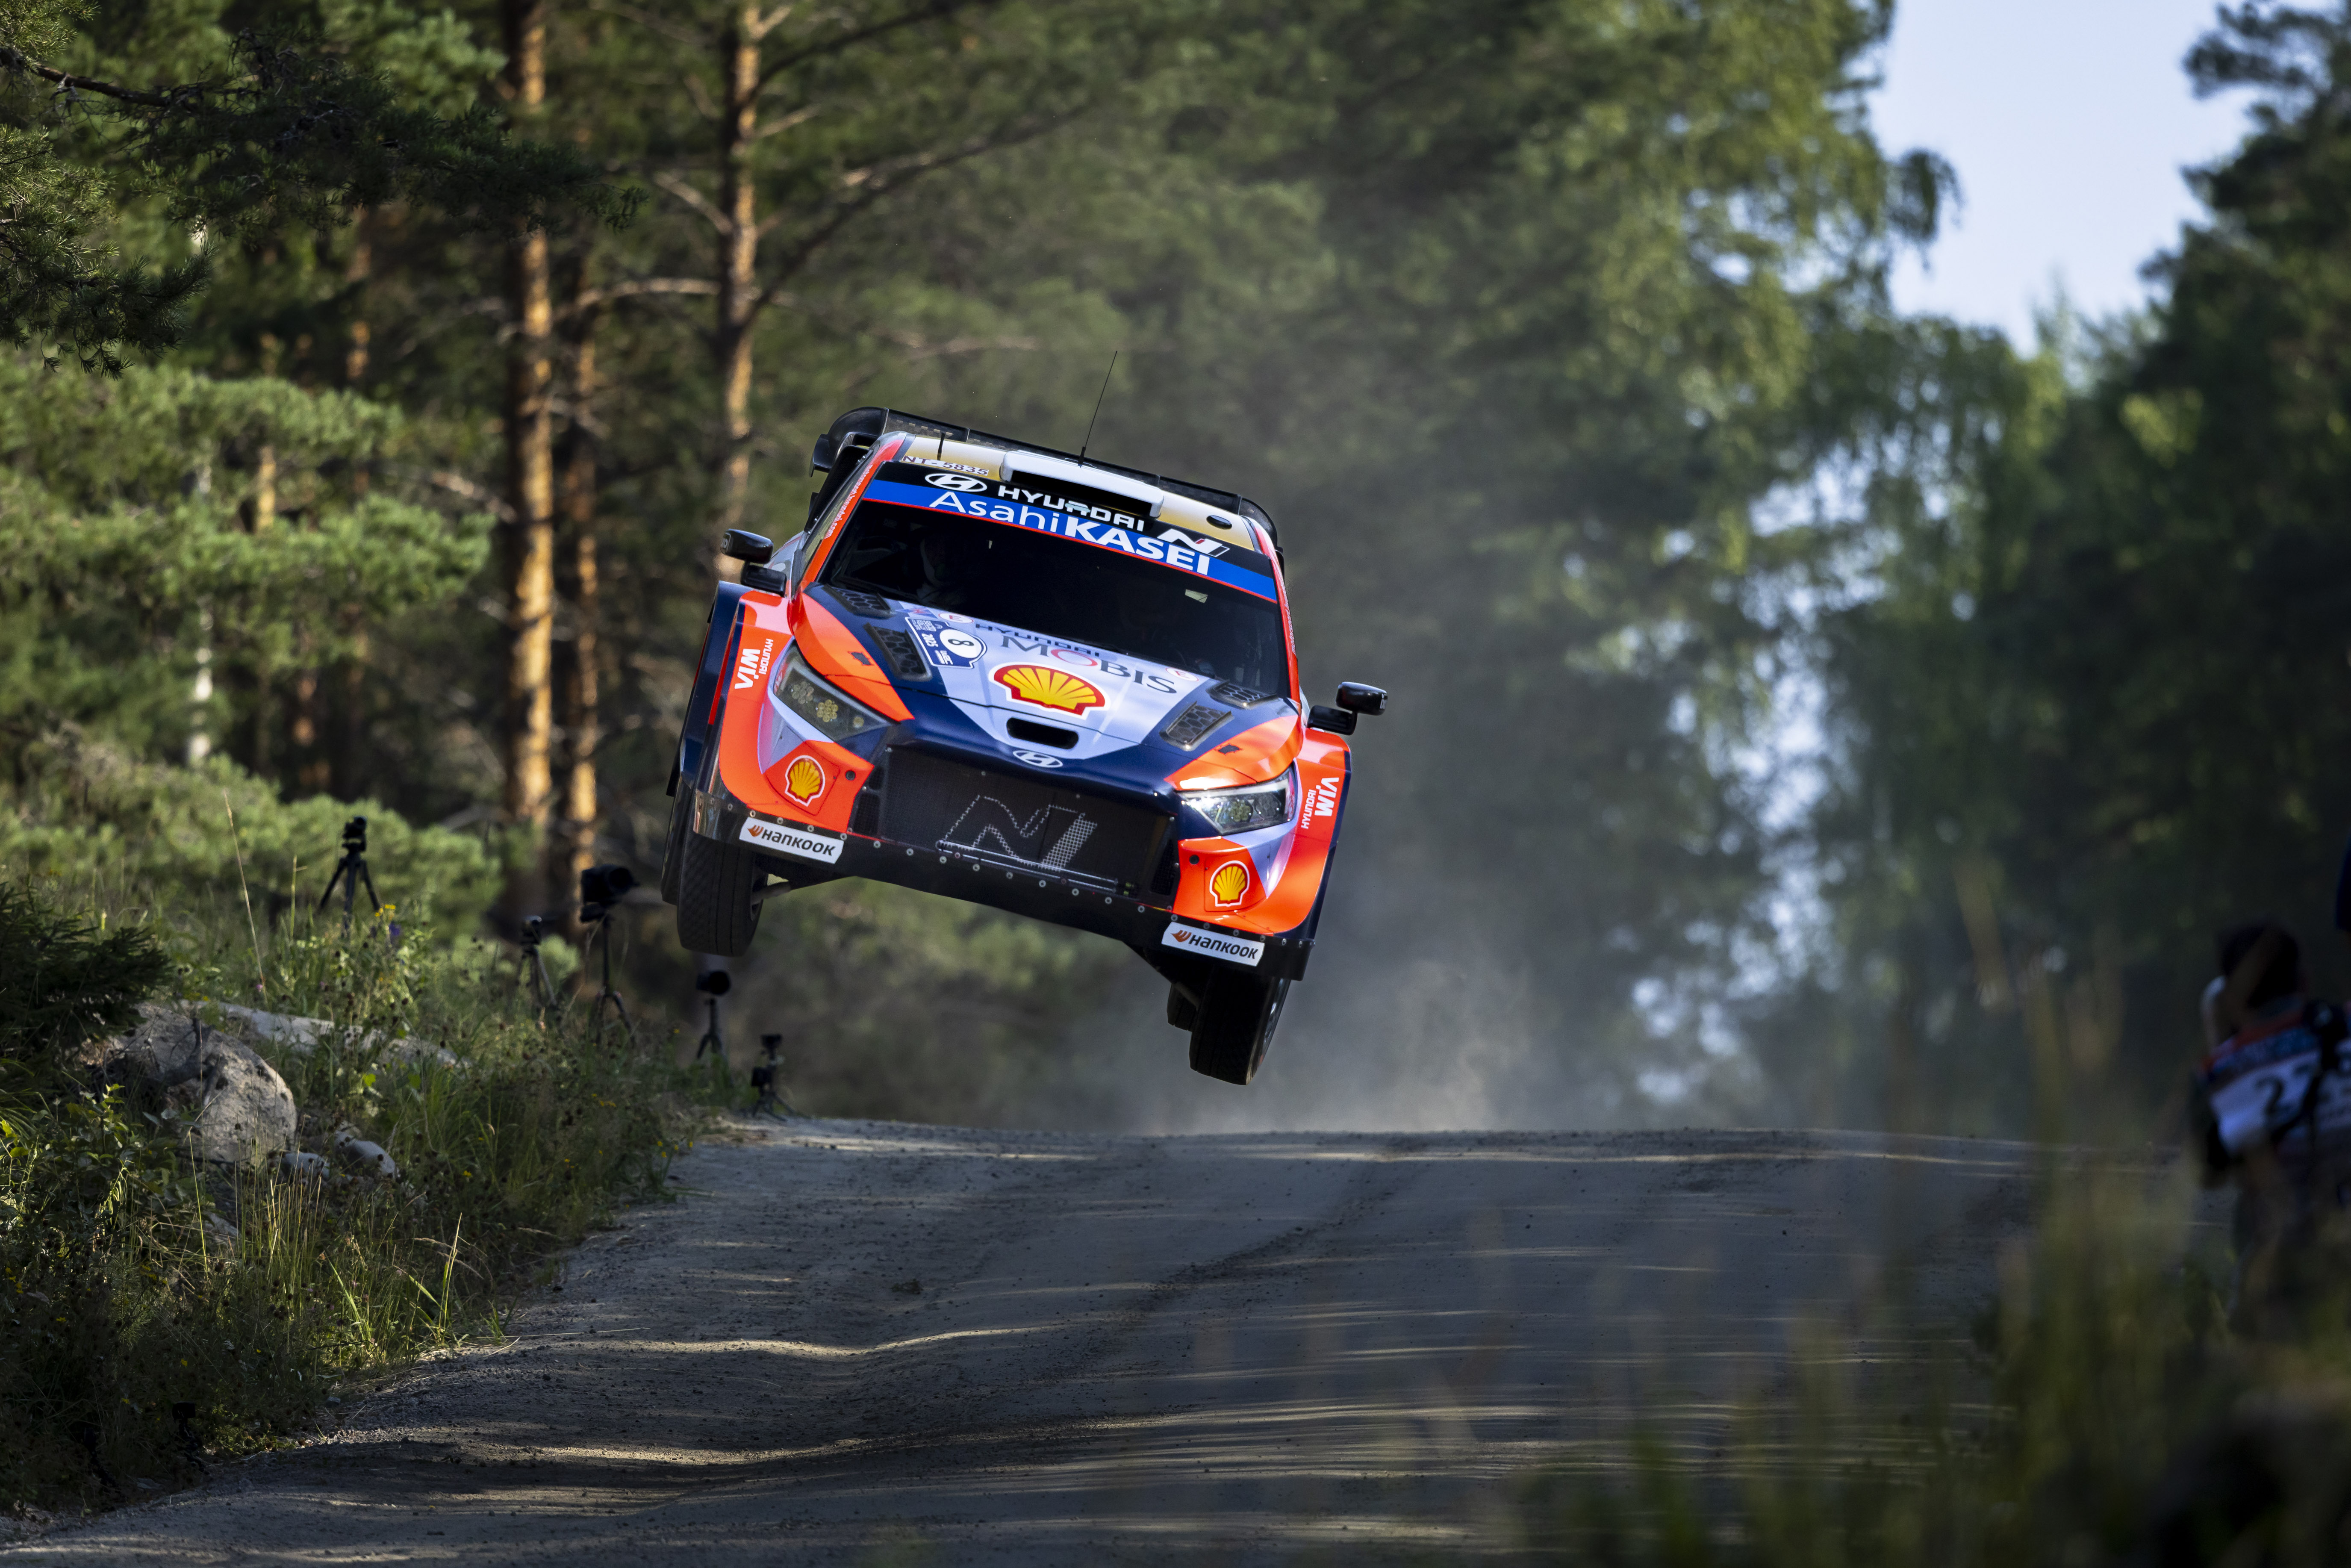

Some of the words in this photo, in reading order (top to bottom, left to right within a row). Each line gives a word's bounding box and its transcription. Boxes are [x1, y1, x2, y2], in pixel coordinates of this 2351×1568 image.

[998, 485, 1144, 532] HYUNDAI
[929, 491, 1210, 575] AsahiKASEI
[758, 638, 774, 675] HYUNDAI
[975, 623, 1099, 657] HYUNDAI
[1001, 635, 1177, 694] MOBIS
[1301, 789, 1317, 829] HYUNDAI
